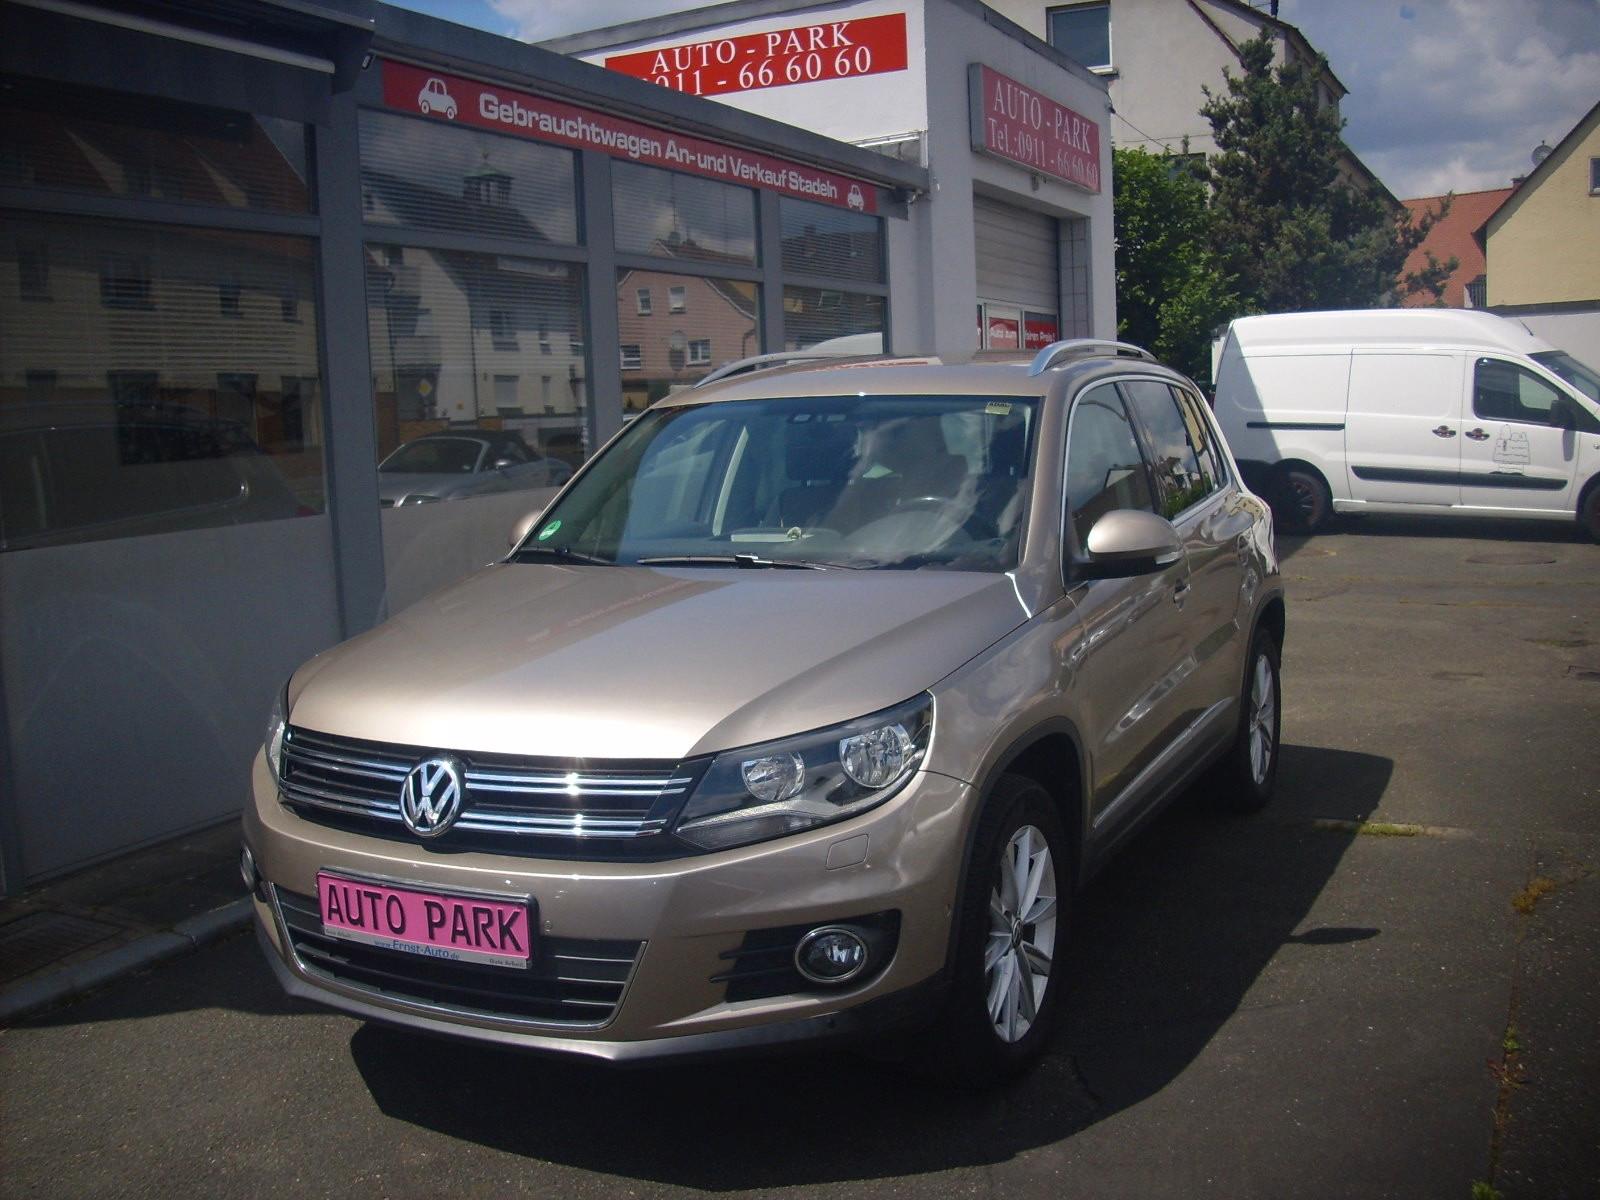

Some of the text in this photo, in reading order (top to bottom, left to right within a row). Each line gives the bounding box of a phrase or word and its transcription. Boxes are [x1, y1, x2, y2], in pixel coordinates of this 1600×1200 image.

[651, 41, 736, 75] AUTO
[766, 22, 853, 57] PARK
[739, 59, 774, 88] 66
[786, 53, 822, 82] 60
[835, 46, 871, 76] 60
[479, 92, 662, 158] Gebrauchtwagen
[729, 155, 789, 187] Verkauf
[788, 171, 838, 199] Stadeln
[994, 79, 1042, 130] AUTO
[1055, 108, 1091, 154] PARK
[327, 884, 524, 953] AUTO PARK
